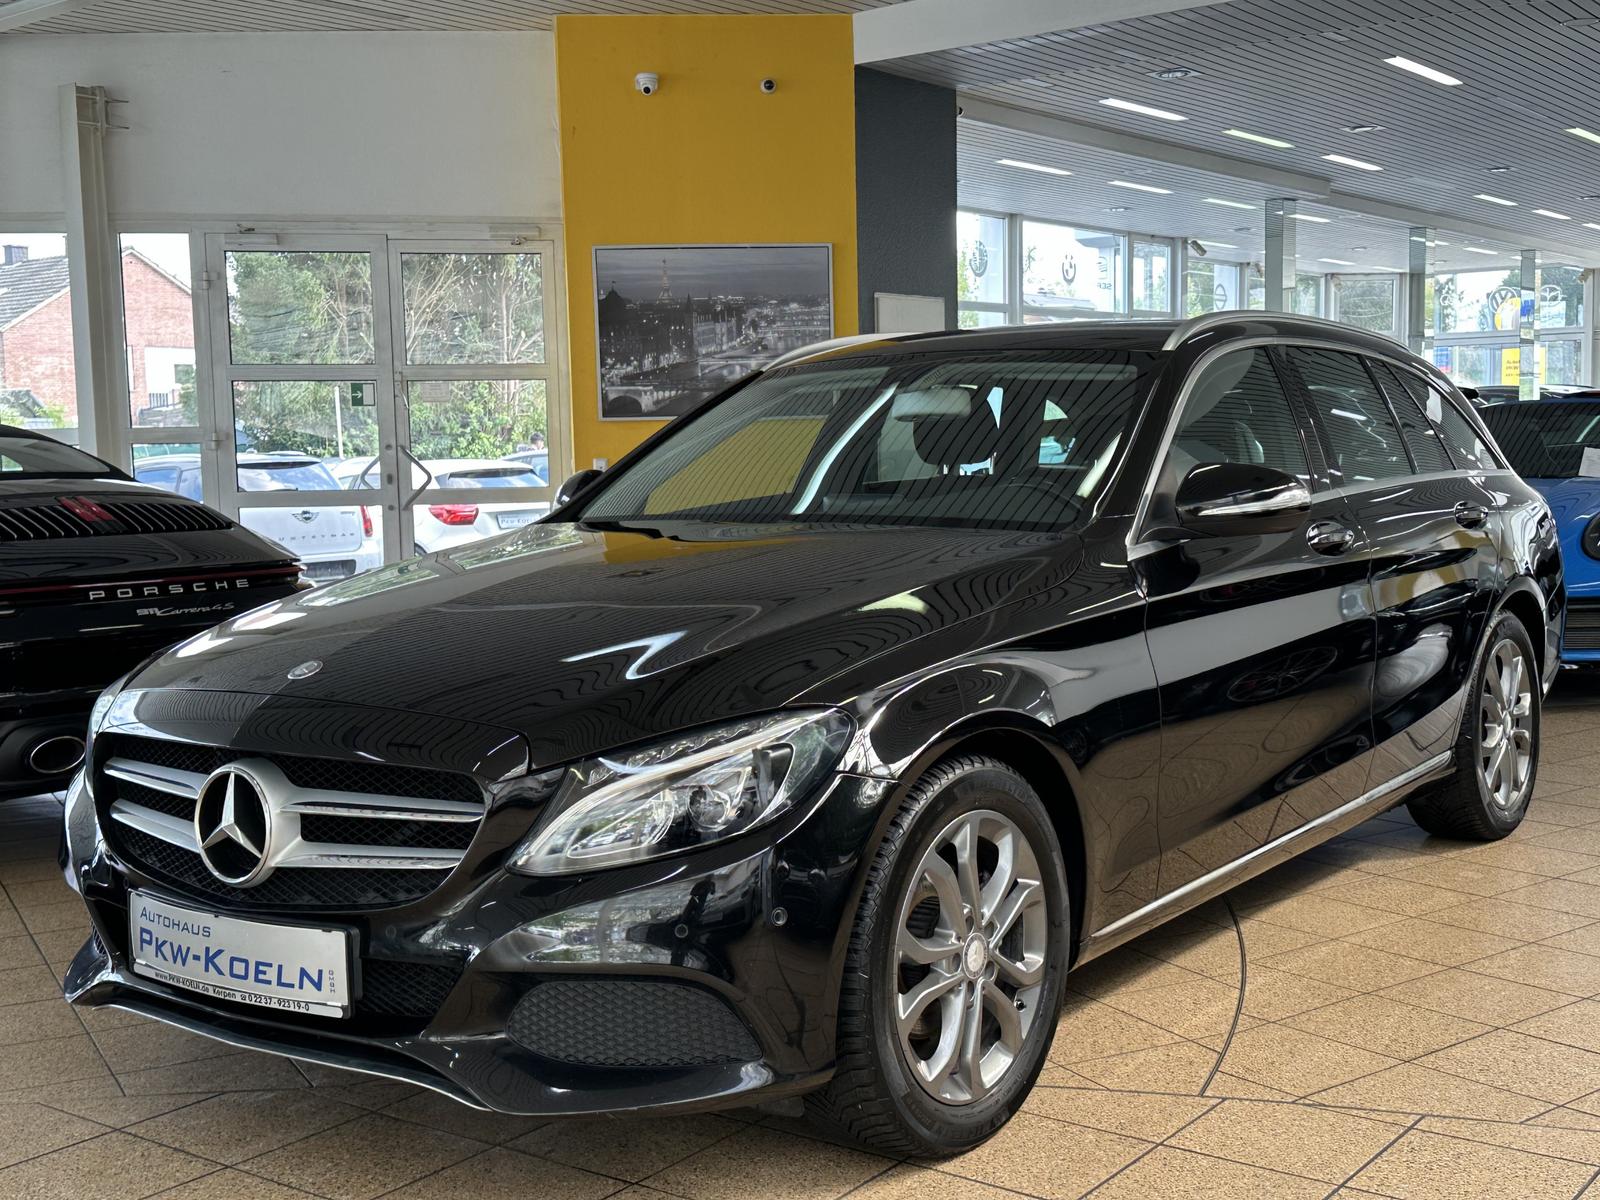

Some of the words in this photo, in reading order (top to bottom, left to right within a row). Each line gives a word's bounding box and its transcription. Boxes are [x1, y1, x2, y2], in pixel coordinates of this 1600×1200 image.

[89, 579, 249, 600] PORSCHE
[140, 906, 211, 938] AUTOHAUS
[139, 926, 324, 992] PKW-KOELN
[212, 986, 237, 999] Kerpen
